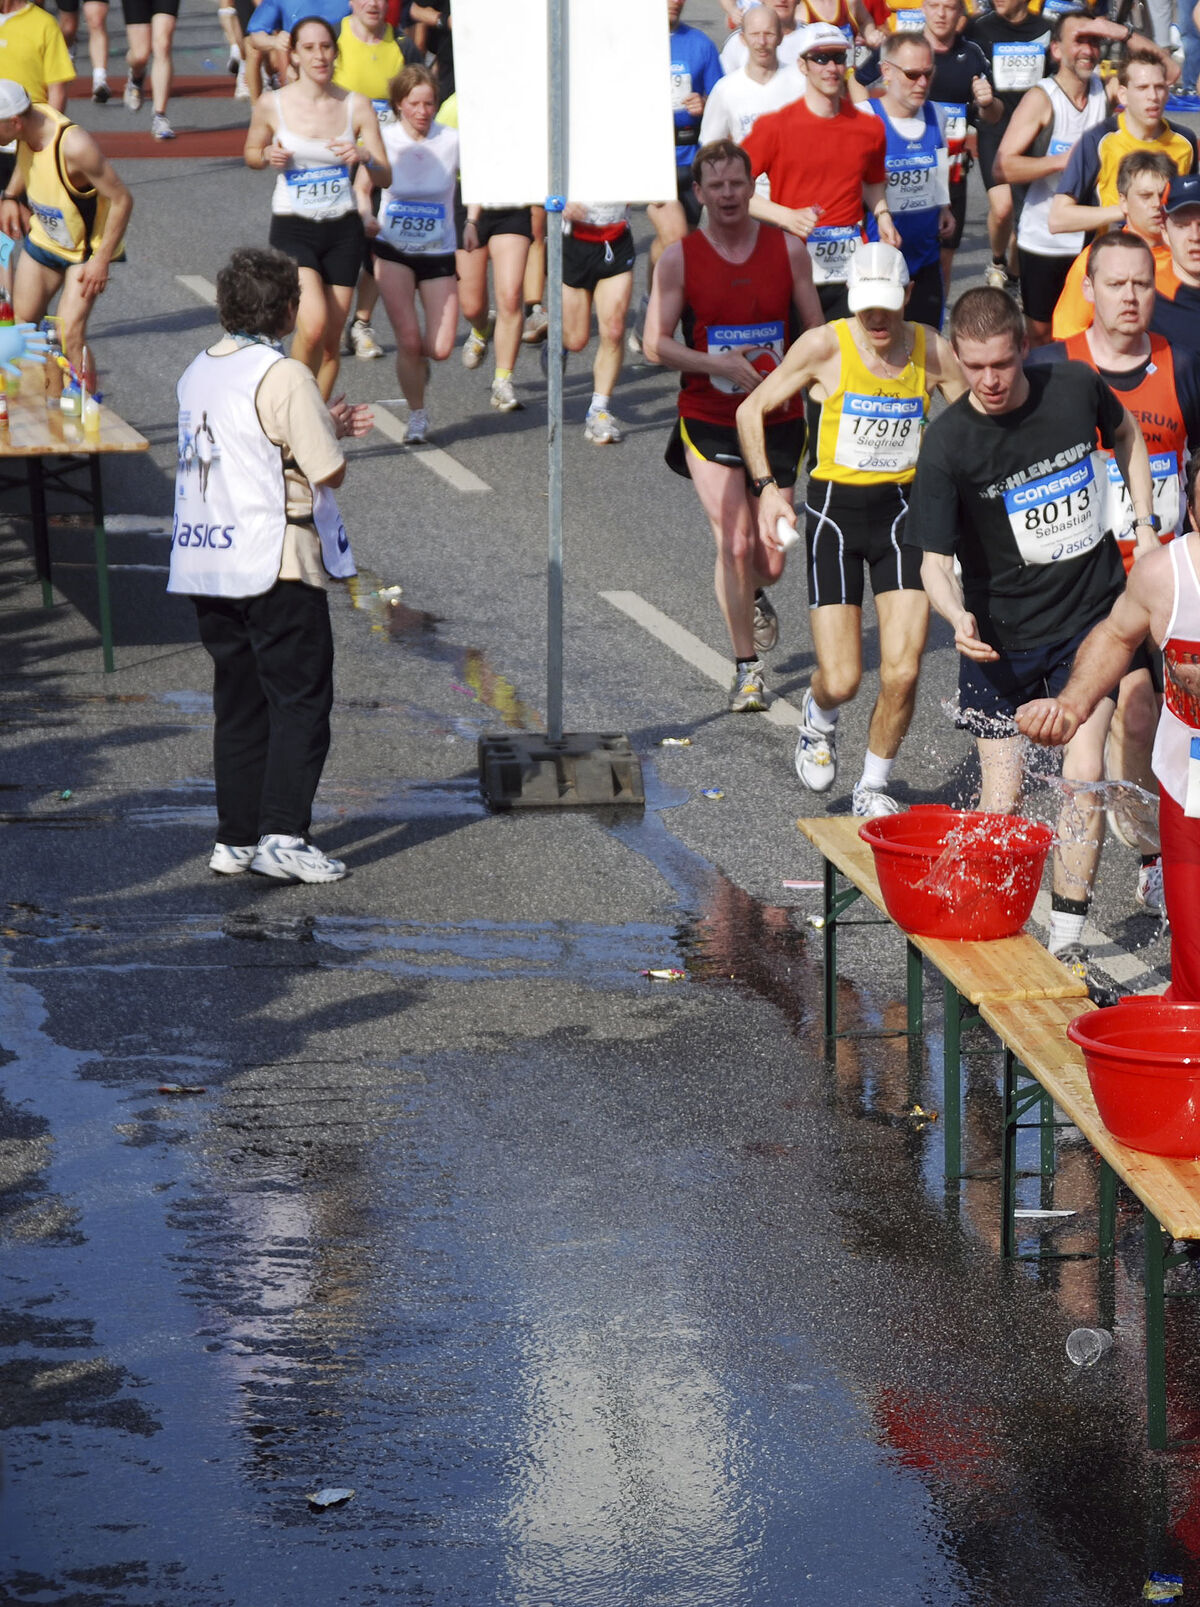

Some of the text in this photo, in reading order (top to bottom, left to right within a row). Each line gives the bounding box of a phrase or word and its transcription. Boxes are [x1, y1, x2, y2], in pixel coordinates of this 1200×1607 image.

[889, 169, 931, 187] 9831
[297, 180, 342, 199] F416
[391, 215, 436, 232] F638
[852, 418, 912, 439] 17918
[856, 436, 905, 449] Siegfried
[1025, 487, 1091, 531] 8013
[1035, 509, 1092, 540] Sebastian
[178, 523, 235, 549] asics
